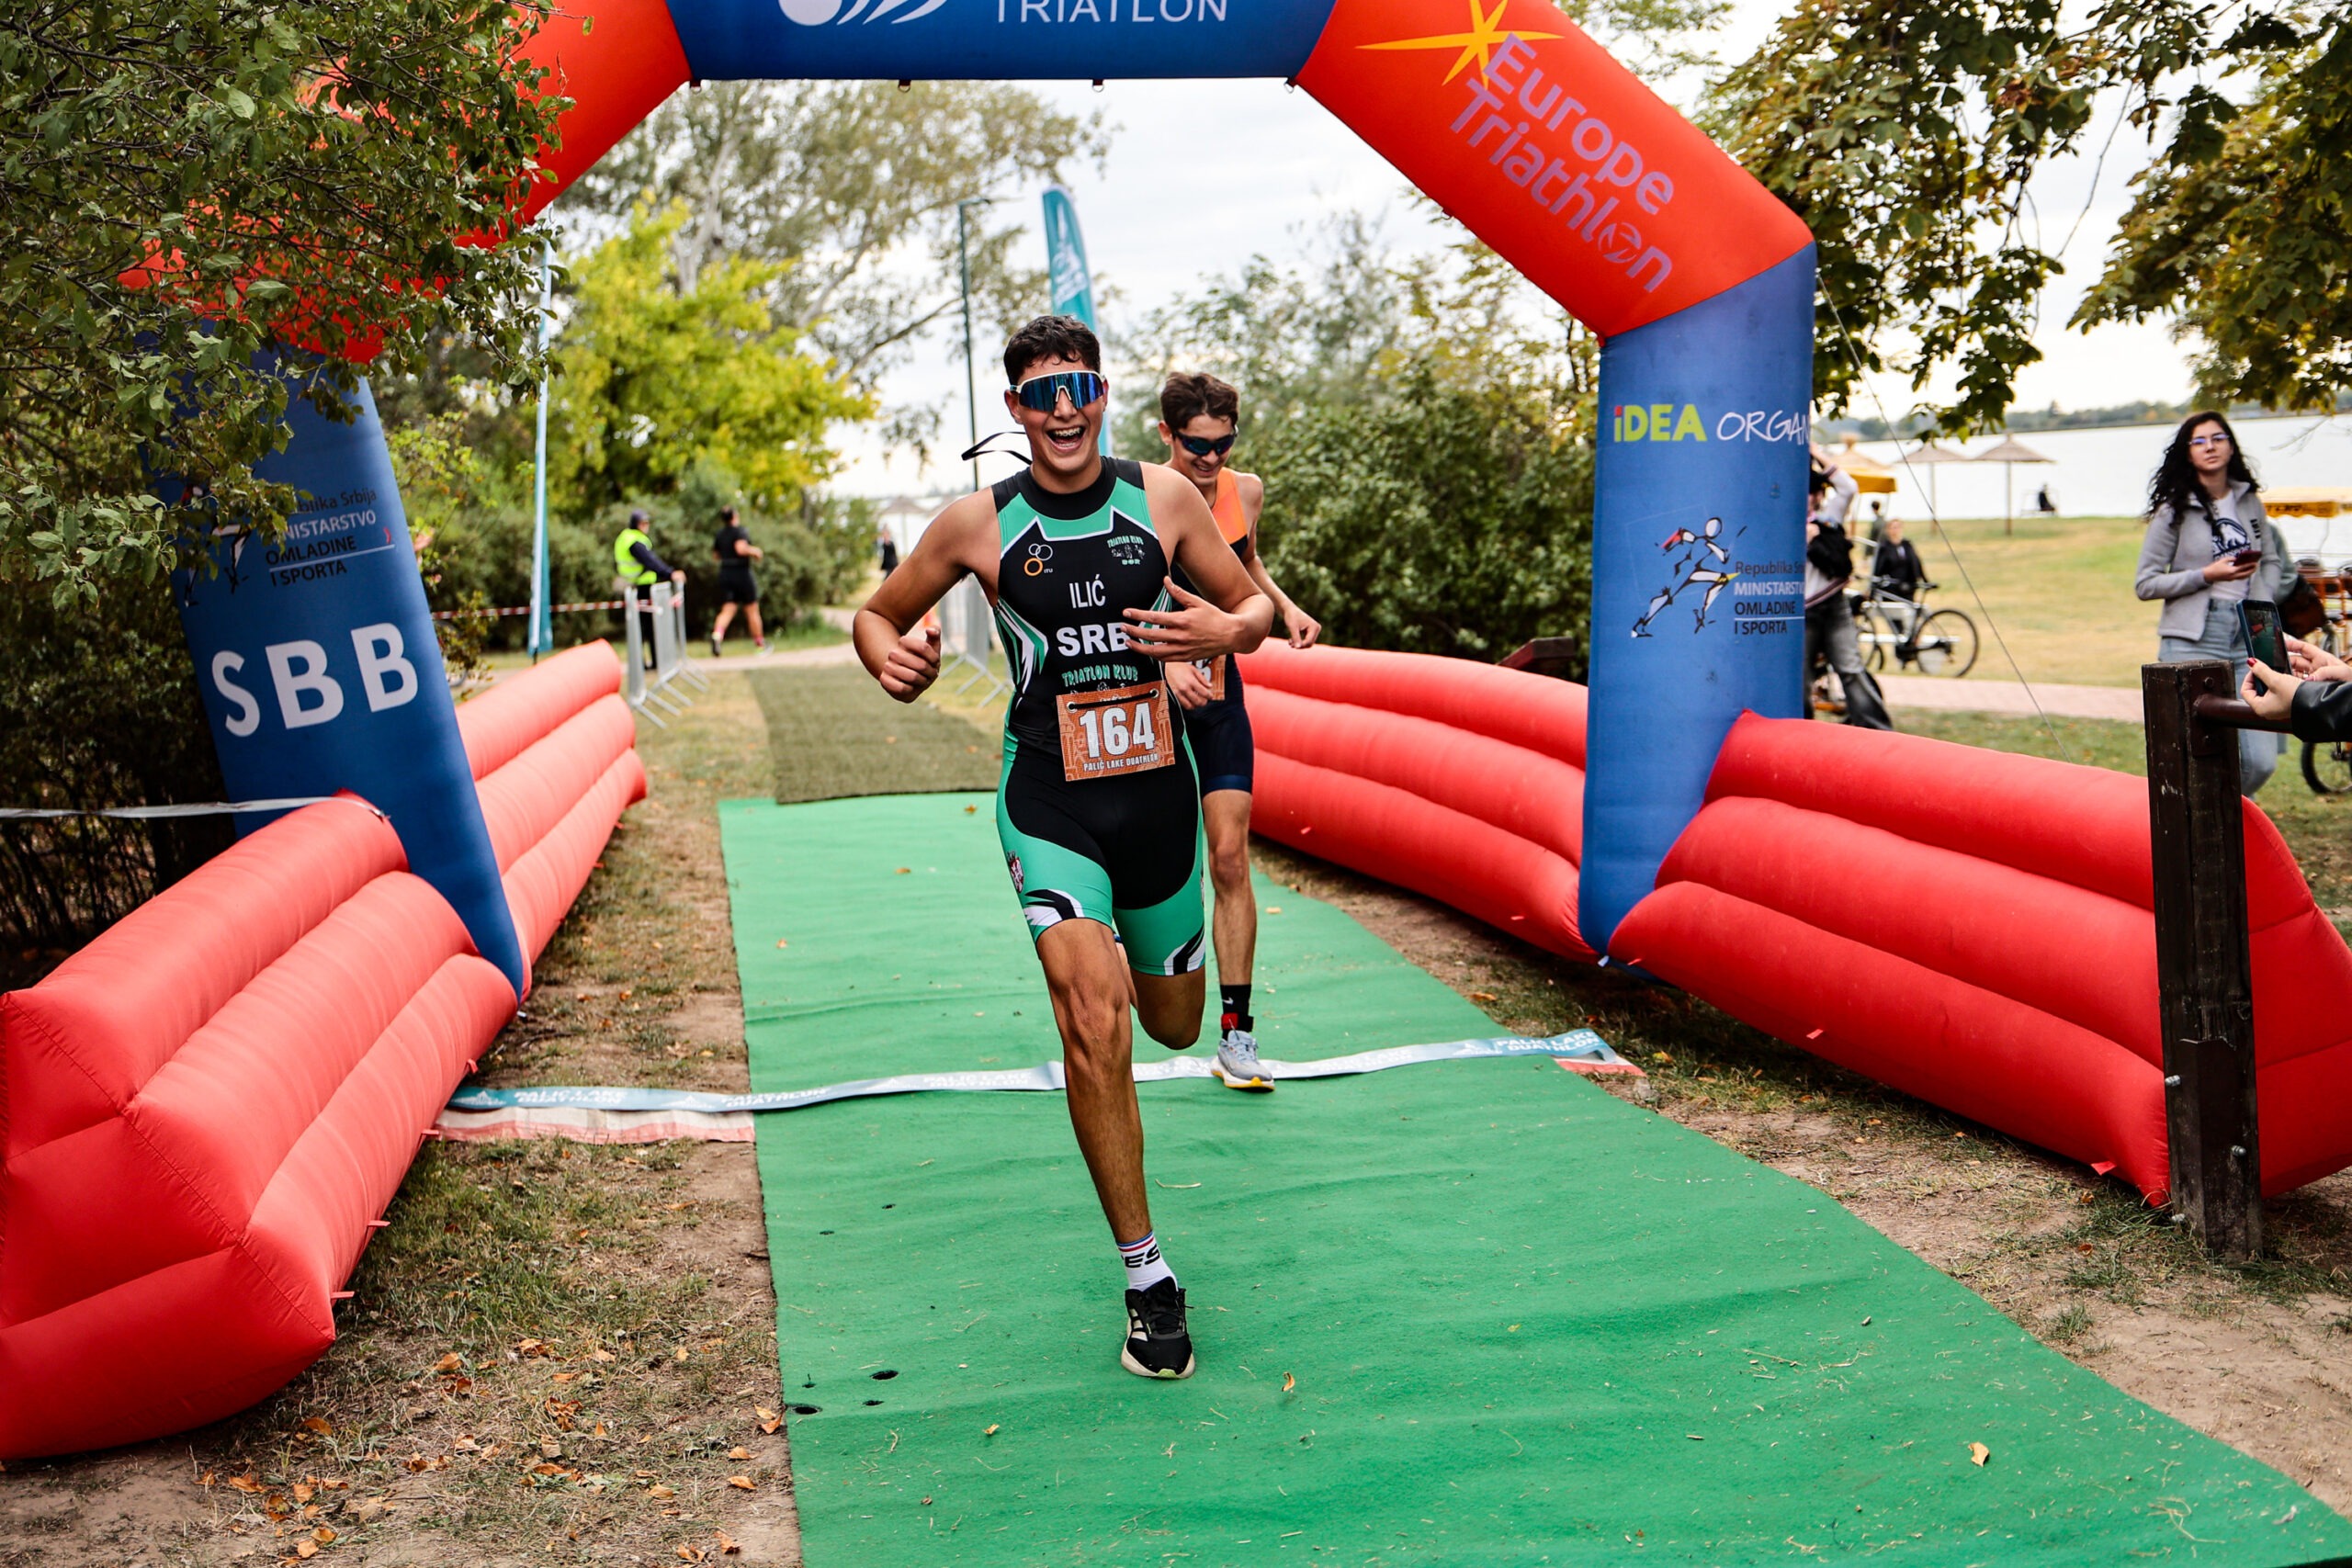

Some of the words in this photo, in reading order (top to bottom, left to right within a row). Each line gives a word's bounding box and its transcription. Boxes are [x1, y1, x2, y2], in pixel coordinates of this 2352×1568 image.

[997, 0, 1228, 23] TRIATLON
[1483, 32, 1674, 216] Europe
[1450, 77, 1673, 294] Triathlon
[340, 488, 377, 506] Srbija
[283, 509, 376, 540] NISTARSTVO
[266, 536, 356, 566] OMLADINE
[270, 571, 277, 587] I
[279, 559, 347, 586] SPORTA
[1736, 560, 1792, 578] Republika
[1069, 574, 1106, 608] ILIĆ
[1735, 601, 1795, 615] OMLADINE
[1735, 621, 1738, 635] I
[1742, 620, 1788, 635] SPORTA
[211, 622, 419, 737] SBB
[1061, 664, 1110, 687] TRIATLON
[1113, 664, 1138, 681] KLUB
[1079, 702, 1156, 758] 164
[1106, 758, 1125, 769] LAKE
[1122, 1244, 1160, 1269] ES
